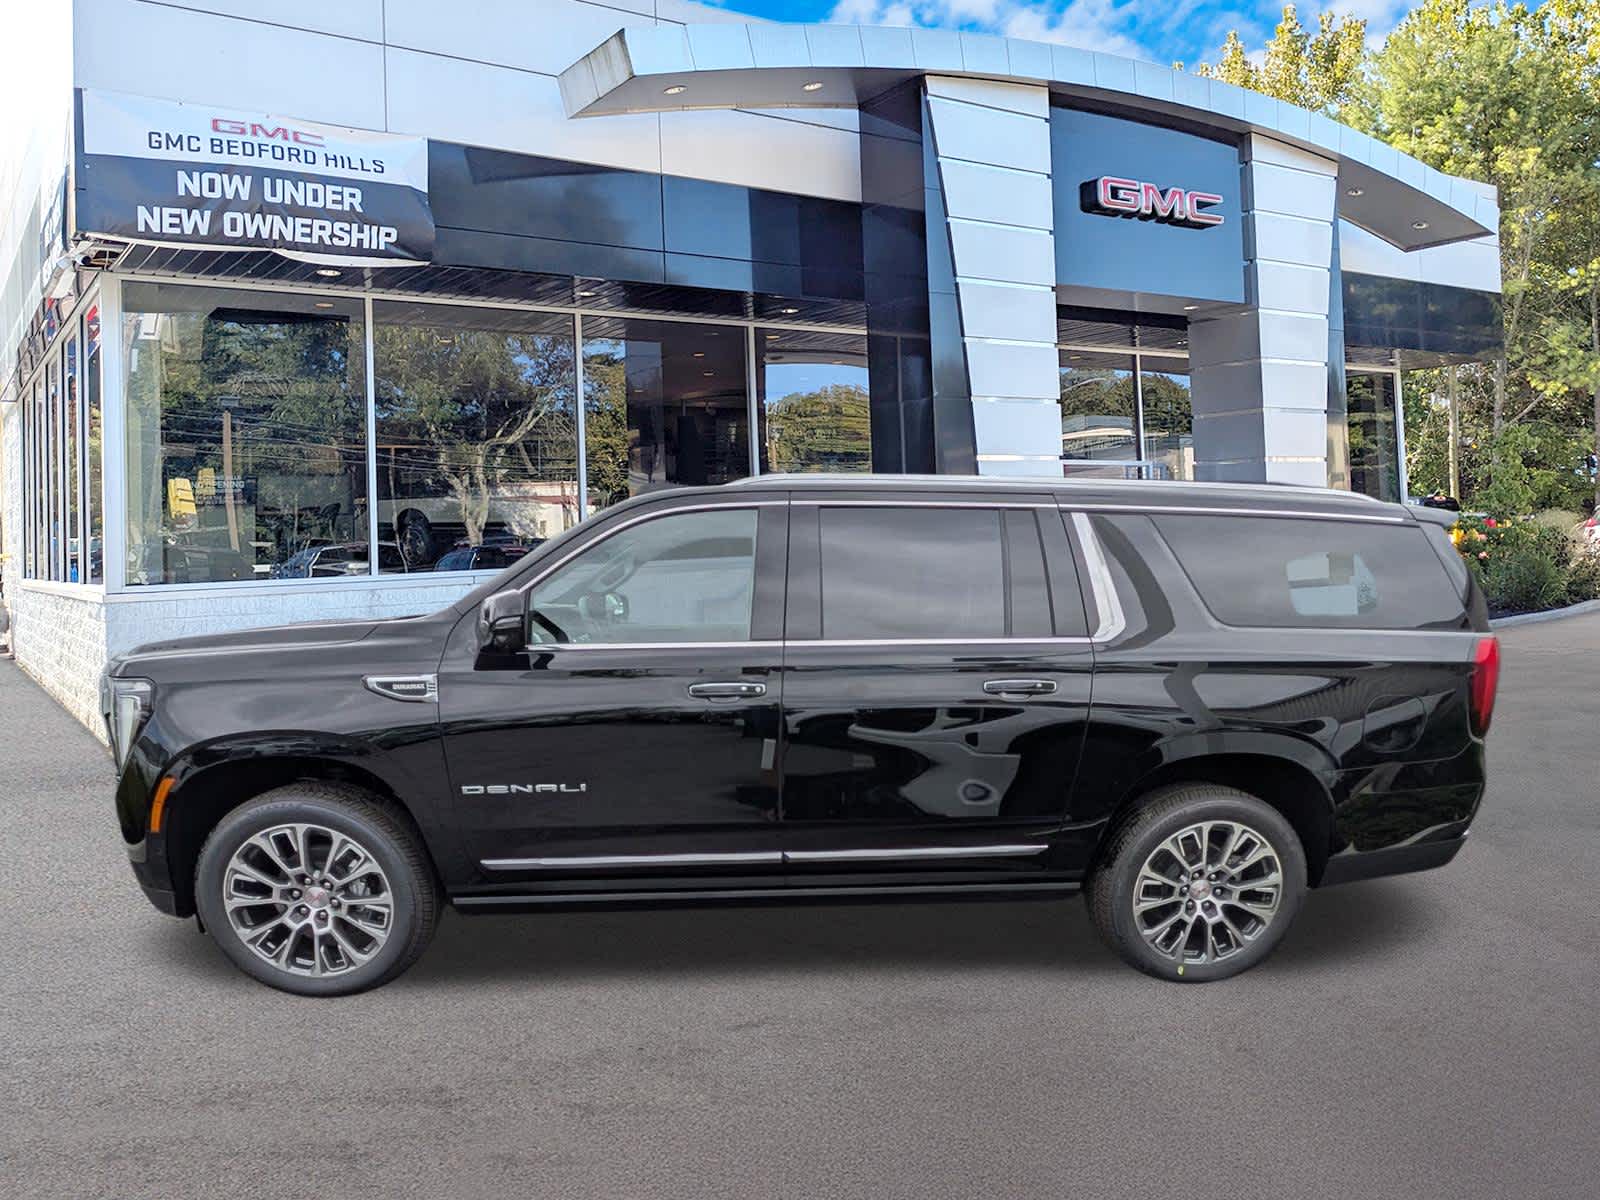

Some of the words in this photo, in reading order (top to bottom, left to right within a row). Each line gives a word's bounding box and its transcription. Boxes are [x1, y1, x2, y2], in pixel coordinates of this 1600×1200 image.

[148, 131, 201, 153] GMC
[210, 137, 317, 165] BEDFORD
[324, 152, 385, 174] HILLS
[210, 118, 326, 148] GMC
[177, 170, 252, 201] NOW
[263, 176, 364, 213] UNDER
[1097, 175, 1225, 225] GMC
[136, 205, 211, 236] NEW
[223, 211, 398, 250] OWNERSHIP
[461, 783, 587, 795] DENALI
